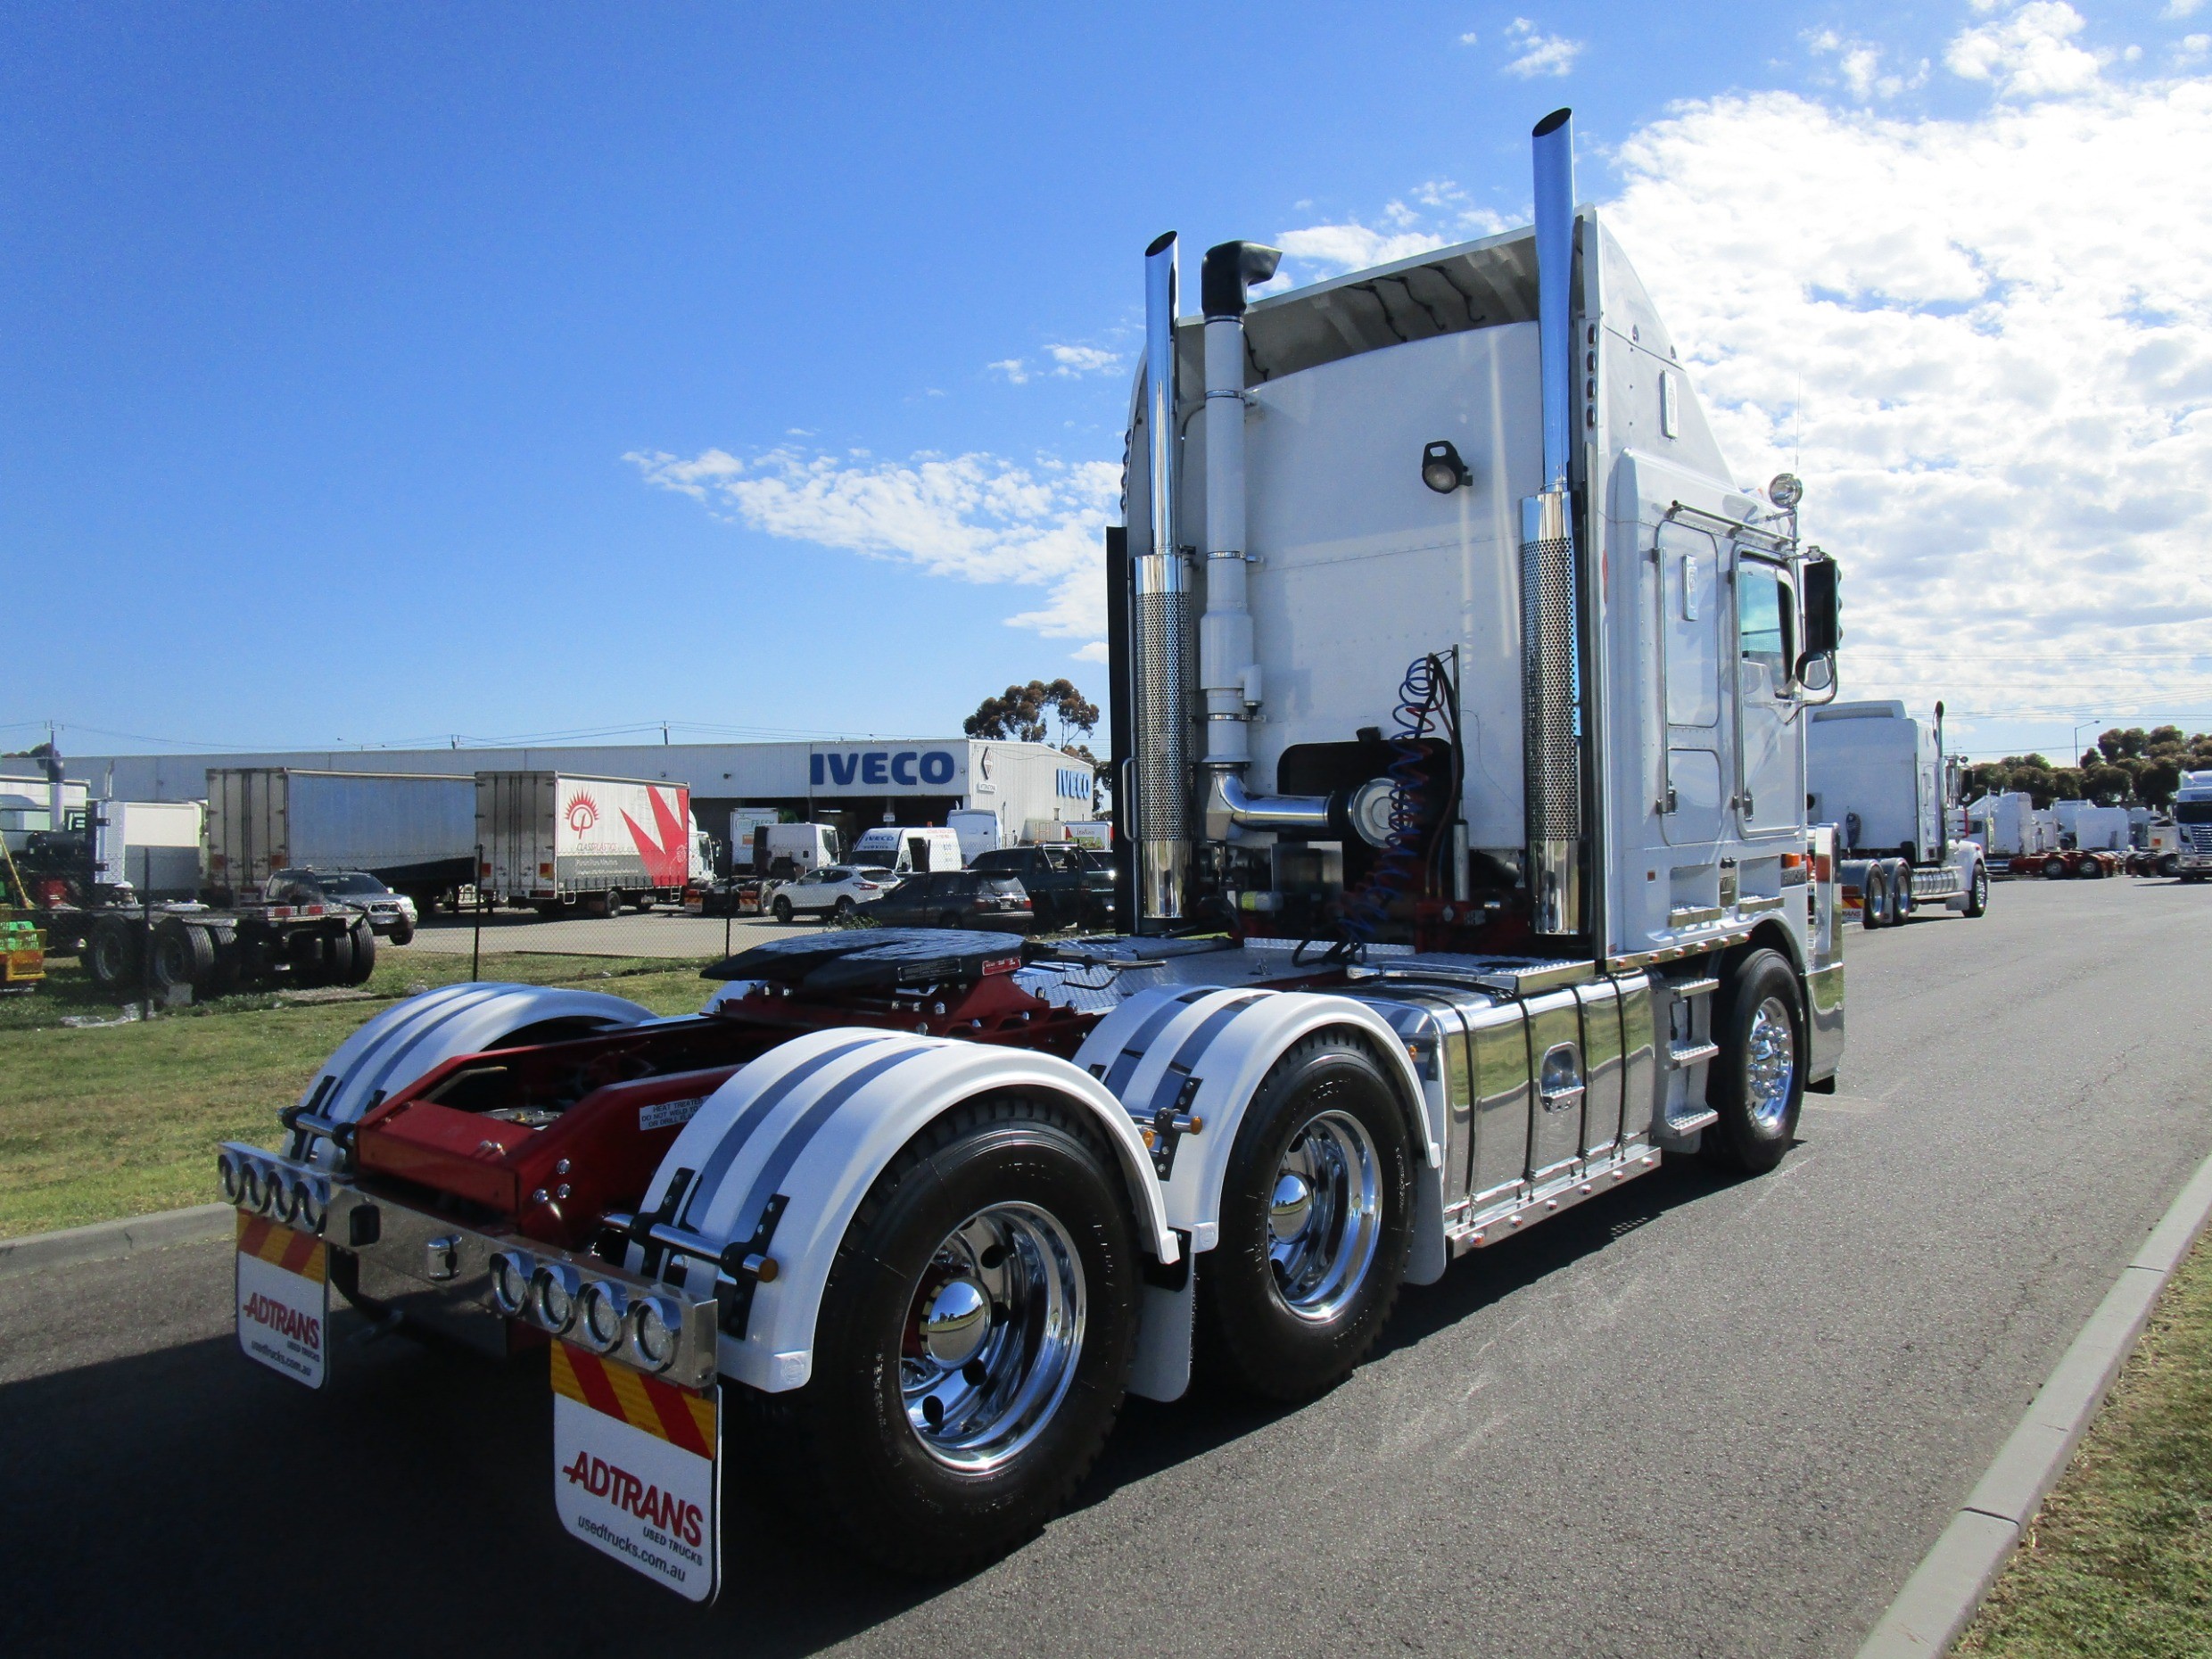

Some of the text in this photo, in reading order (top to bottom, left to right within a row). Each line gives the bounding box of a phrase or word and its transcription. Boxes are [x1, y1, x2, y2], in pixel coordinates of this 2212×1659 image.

[810, 752, 954, 785] IVECO
[1056, 769, 1092, 800] IVECO
[653, 1099, 703, 1112] HEAT TREATED
[670, 1109, 688, 1117] WELD
[243, 1292, 319, 1349] ADTRANS
[563, 1451, 703, 1548] ADTRANS
[578, 1515, 686, 1582] usedtrucks.com.au
[643, 1526, 703, 1566] USED TRUCKS
